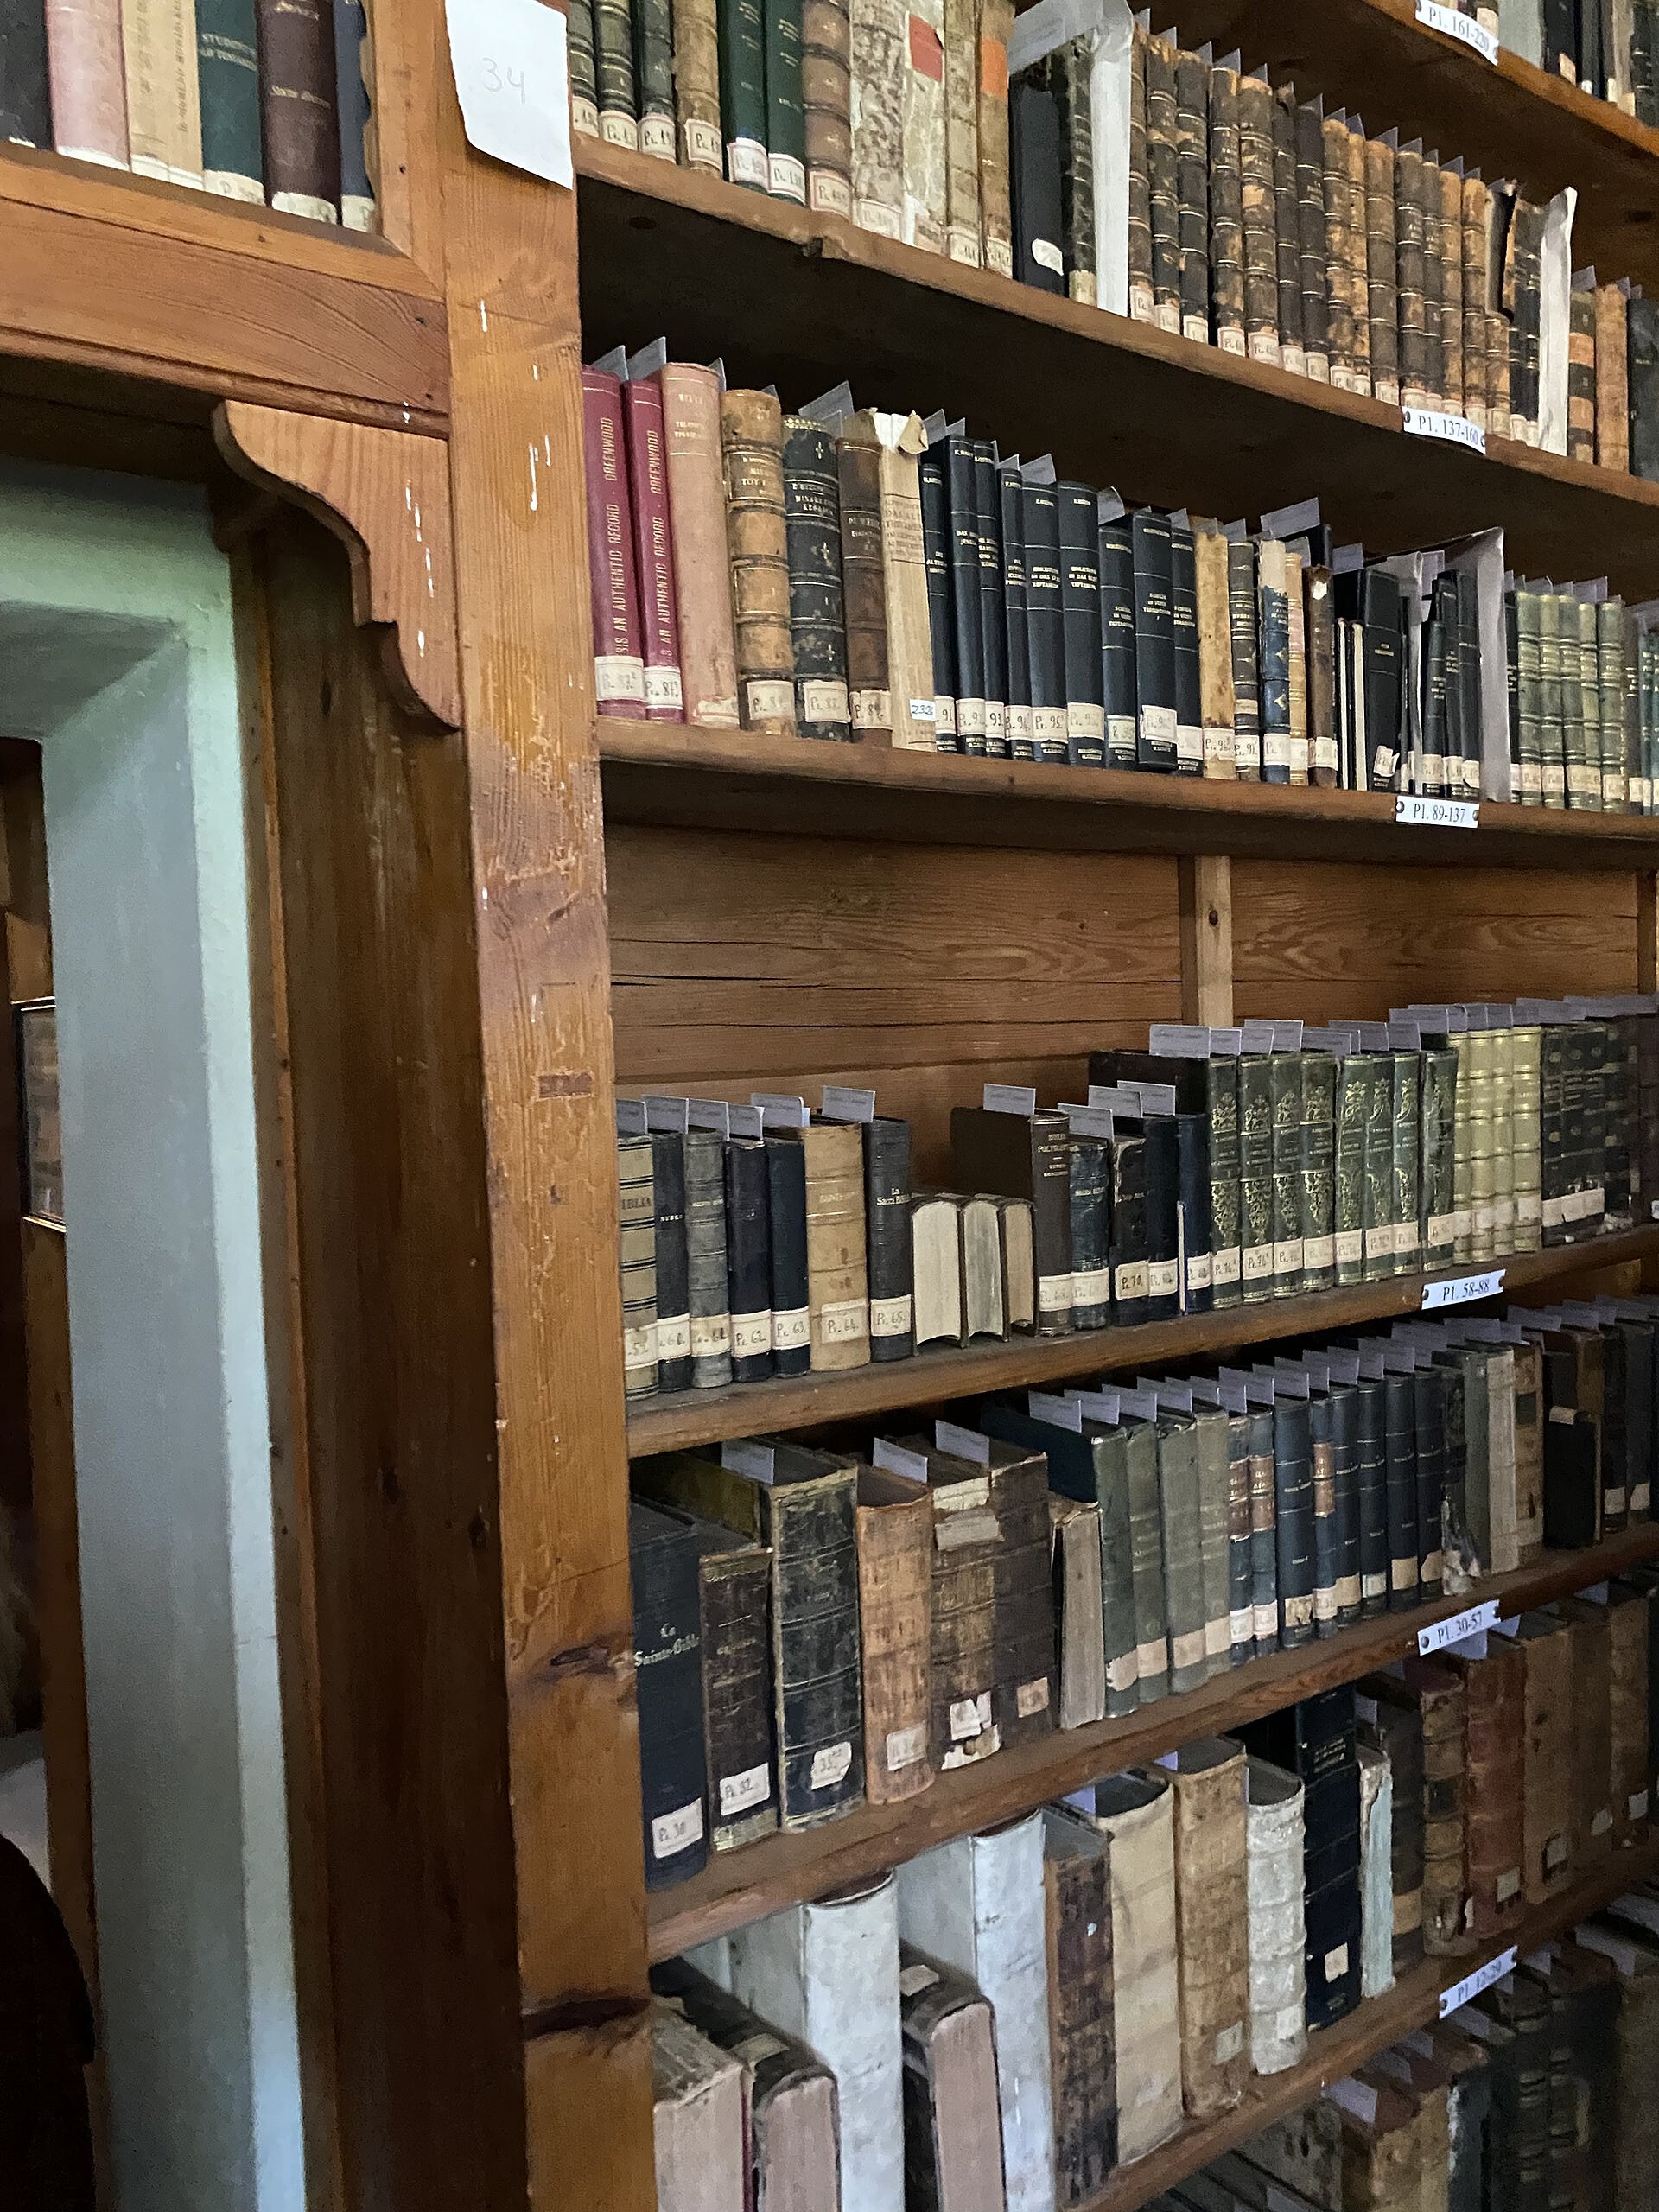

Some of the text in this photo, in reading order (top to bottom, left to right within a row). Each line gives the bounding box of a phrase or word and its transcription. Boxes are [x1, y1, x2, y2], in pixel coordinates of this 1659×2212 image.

[482, 57, 526, 105] 34
[613, 617, 628, 632] AN
[658, 628, 671, 644] AN
[1432, 804, 1465, 823] 89-137
[1462, 1278, 1491, 1299] 58-88
[1456, 1610, 1482, 1636] 30-57
